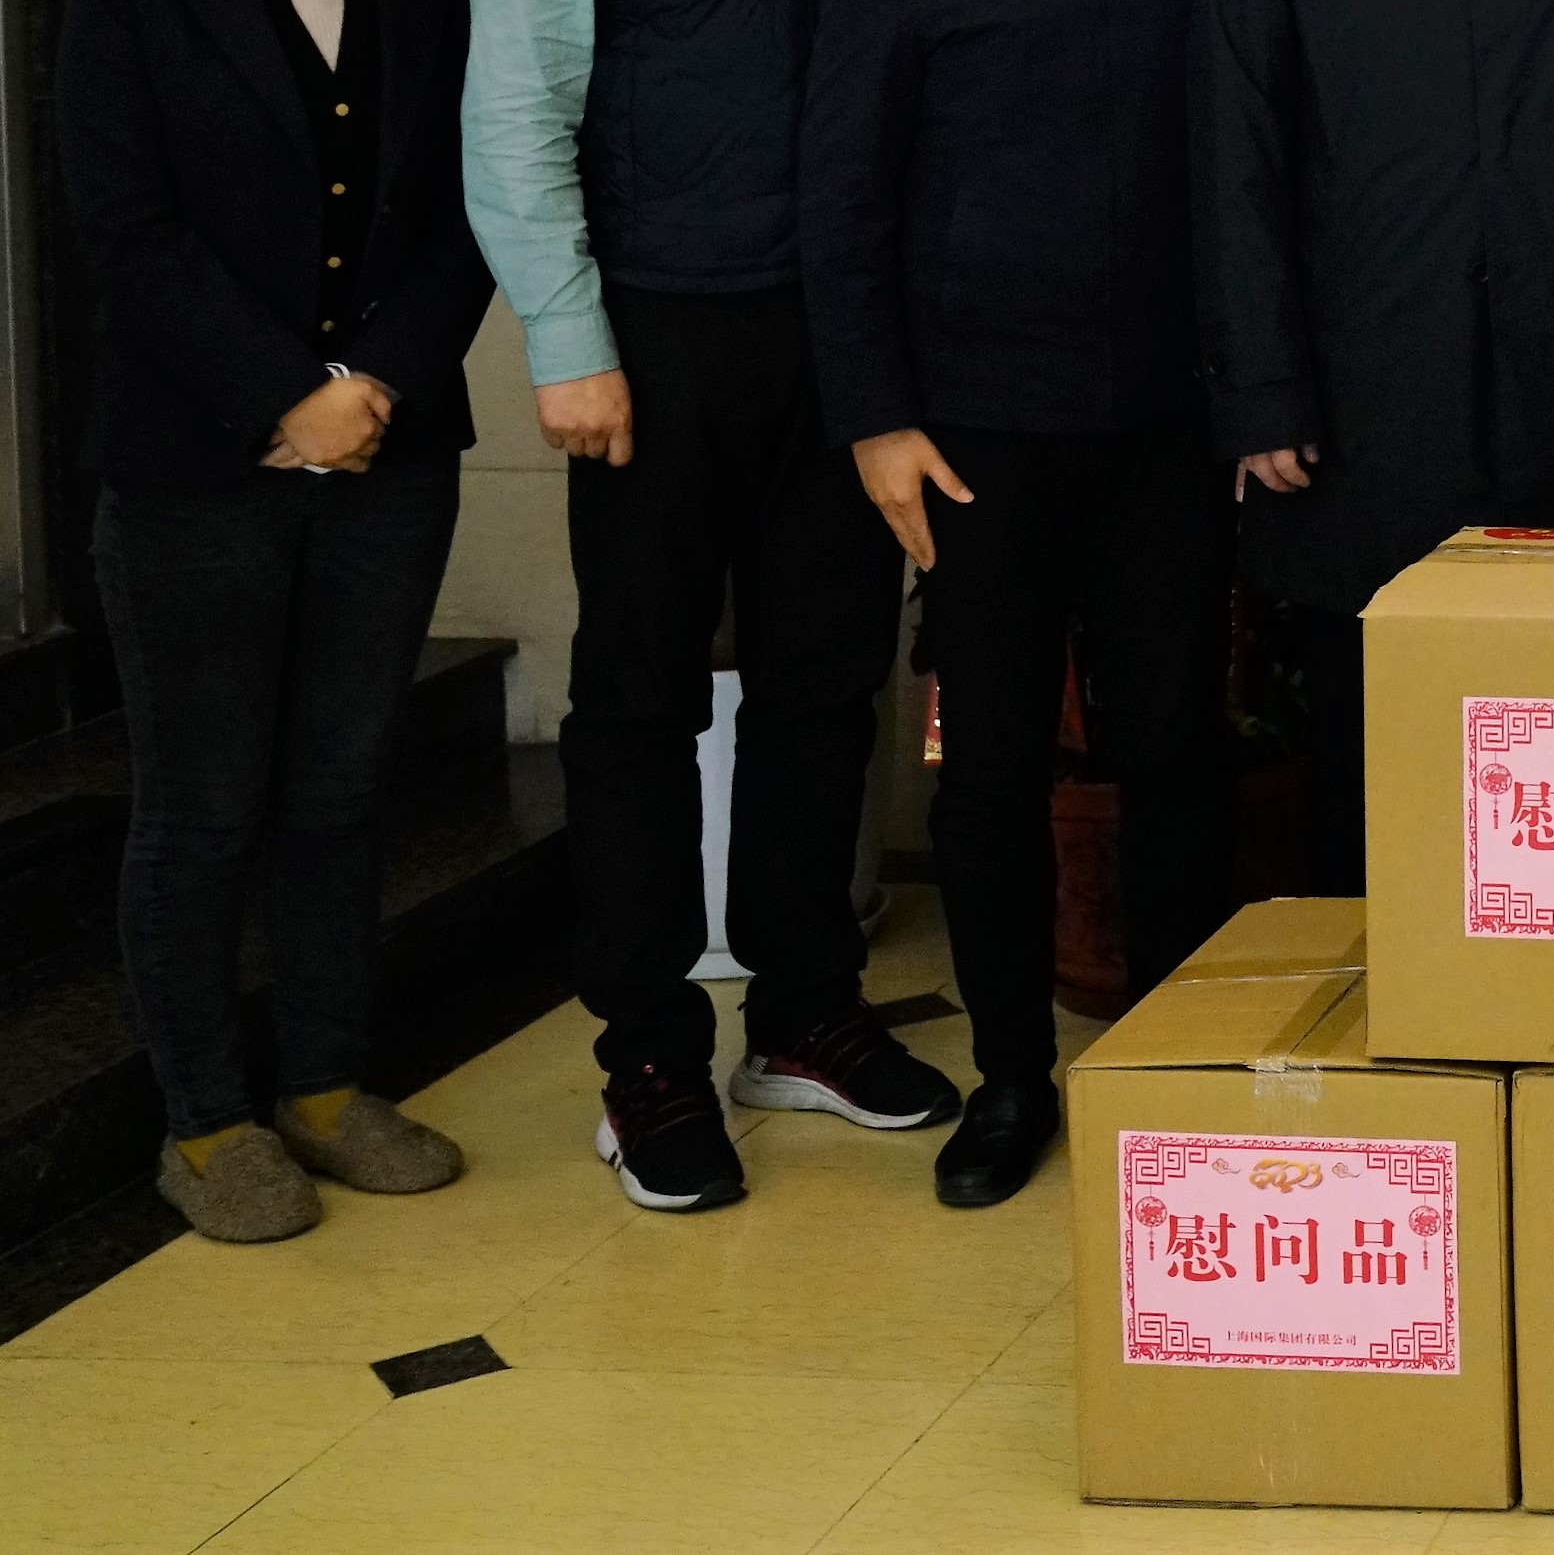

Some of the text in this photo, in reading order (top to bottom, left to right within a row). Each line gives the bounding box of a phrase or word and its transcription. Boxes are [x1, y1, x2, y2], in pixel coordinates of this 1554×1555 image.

[1166, 1212, 1408, 1286] 慰问品
[1226, 1329, 1358, 1348] 上海国际集团有限公司
